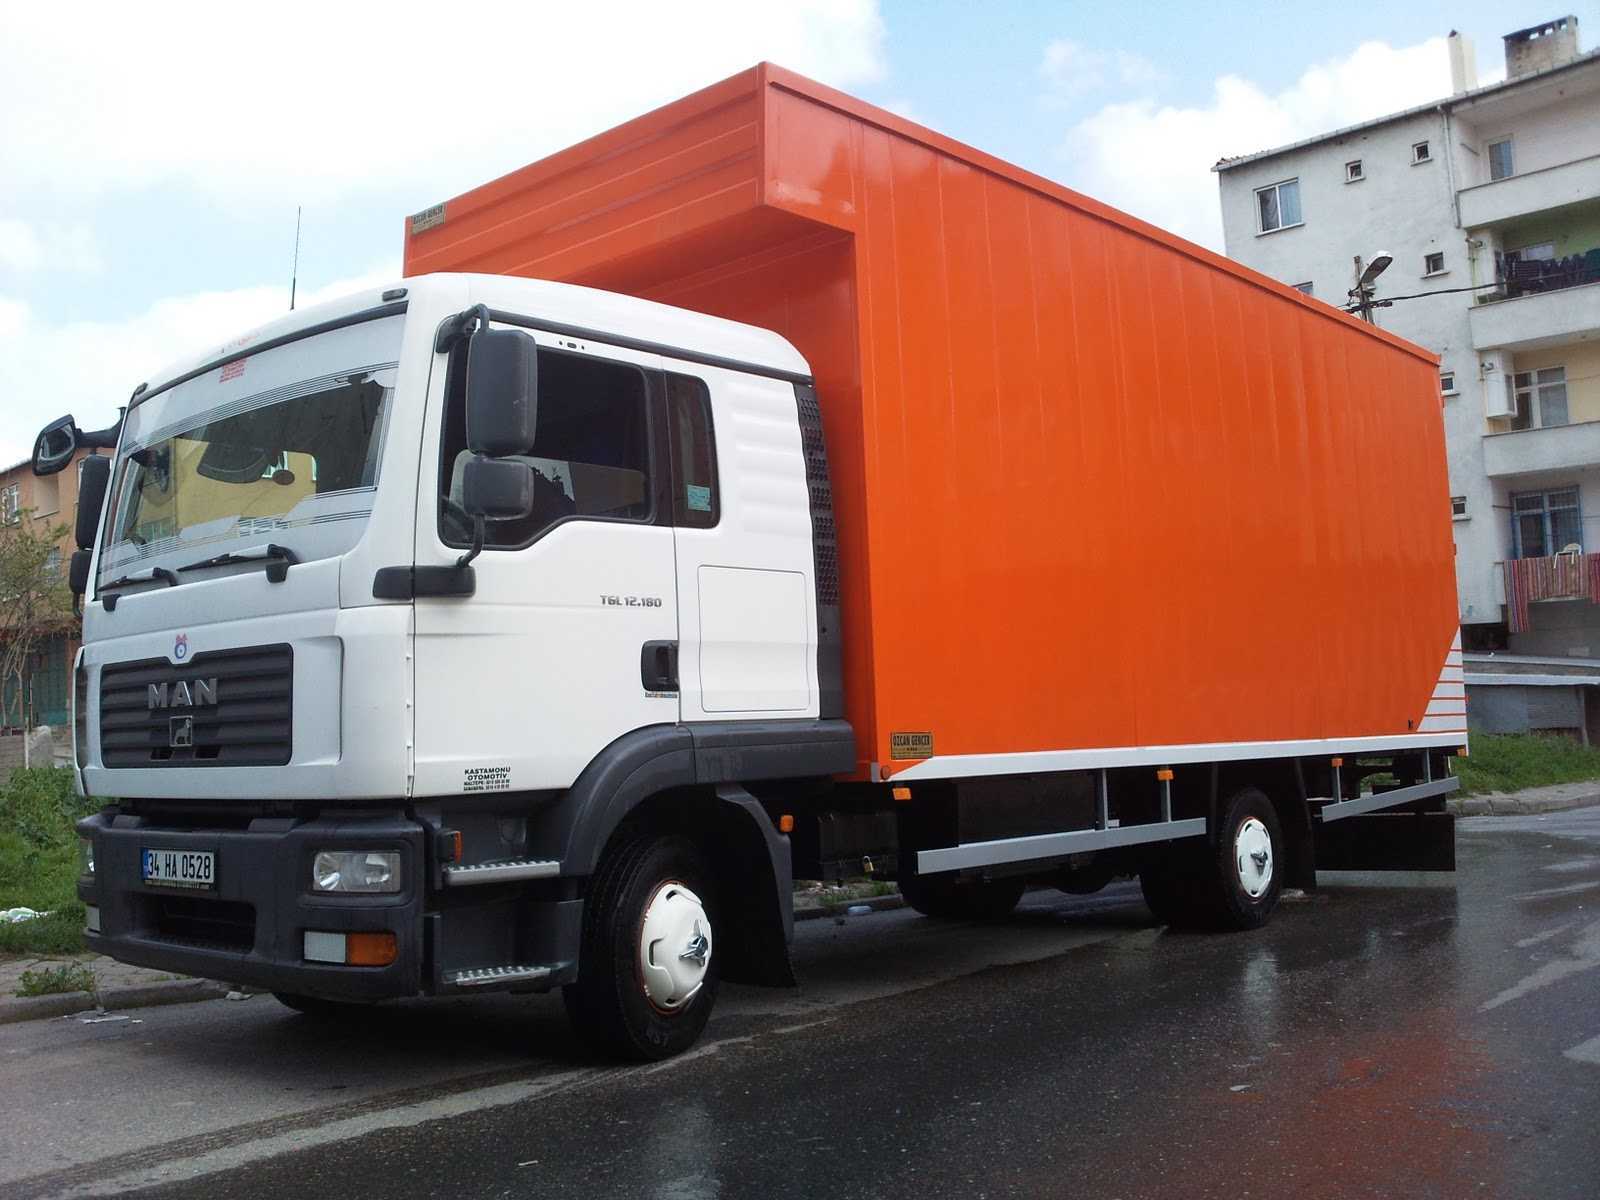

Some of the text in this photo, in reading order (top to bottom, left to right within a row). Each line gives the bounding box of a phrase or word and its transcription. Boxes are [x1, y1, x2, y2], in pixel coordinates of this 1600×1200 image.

[600, 595, 662, 608] TGL 12.180
[148, 678, 217, 709] MAN
[464, 766, 511, 775] KASTAMONU
[148, 853, 211, 879] 34 HA 0528
